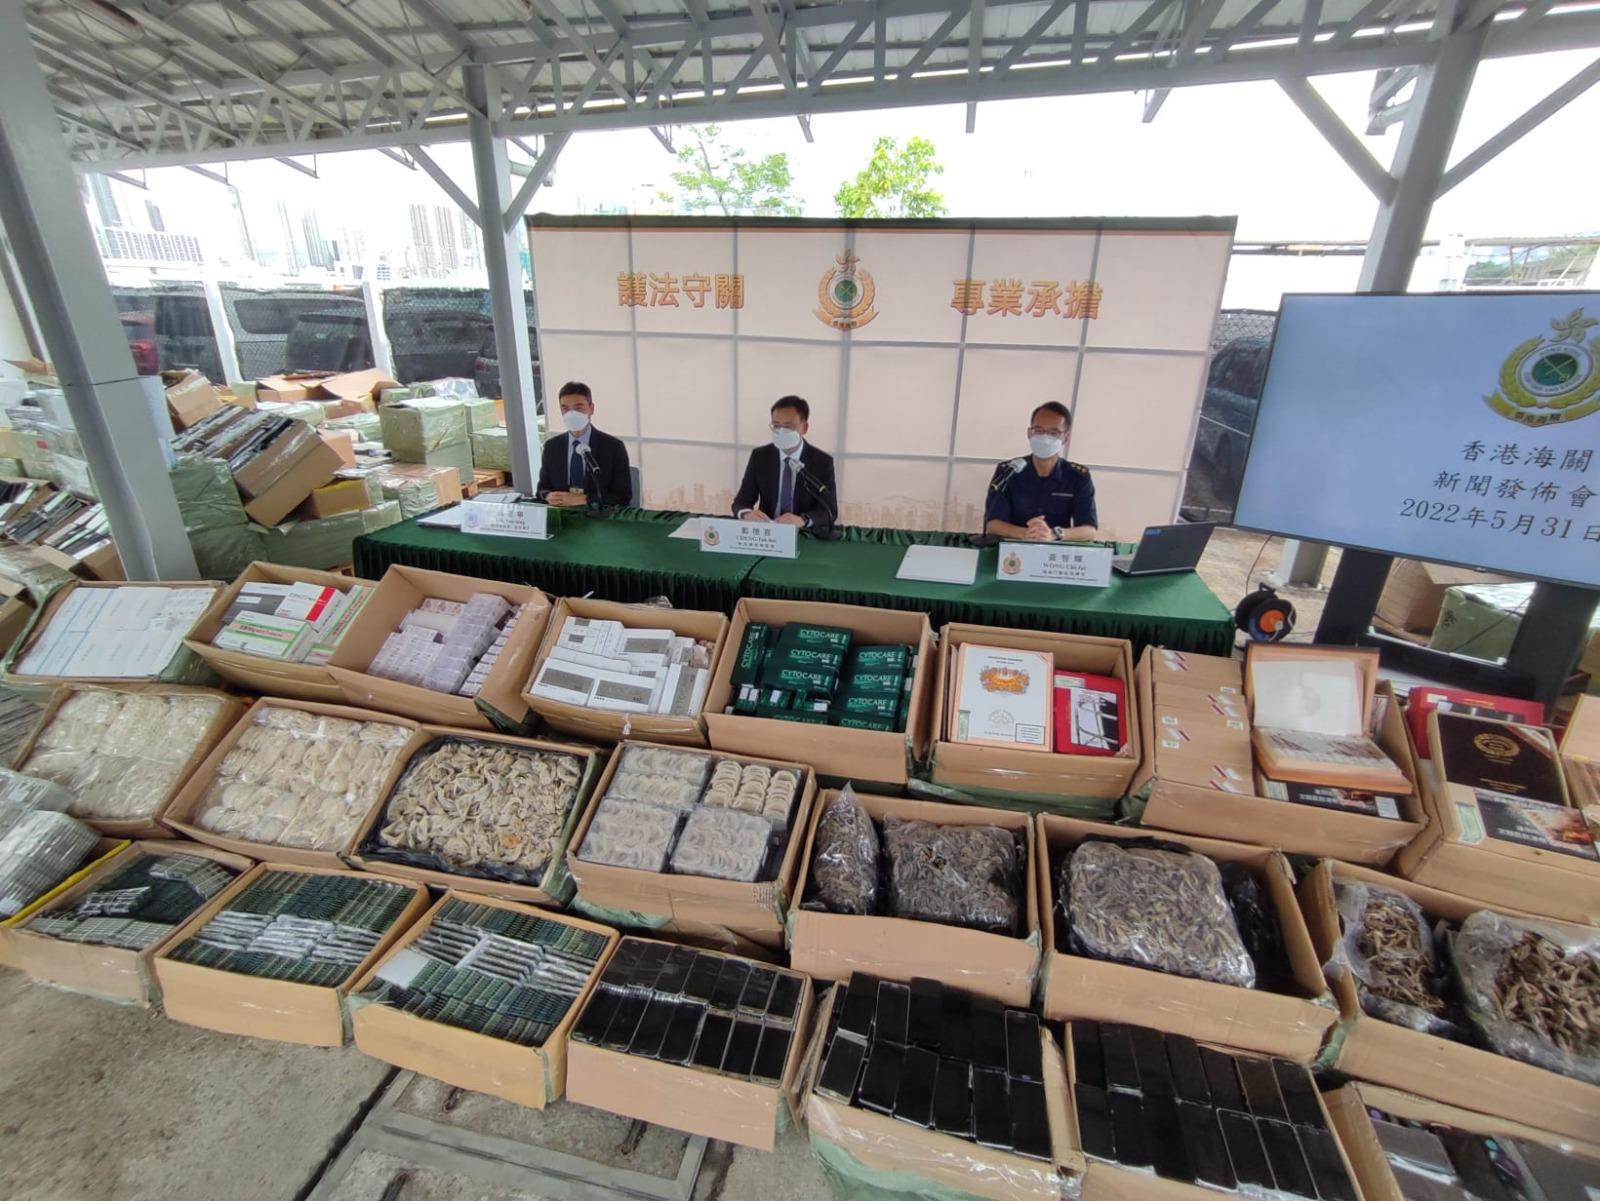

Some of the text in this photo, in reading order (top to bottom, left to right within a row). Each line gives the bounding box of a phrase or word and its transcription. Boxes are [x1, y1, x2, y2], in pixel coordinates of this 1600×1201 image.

[617, 271, 745, 309] 護法守關
[951, 278, 1103, 320] 專業承擔
[1460, 440, 1594, 473] 香港海關
[1432, 470, 1598, 508] 新聞發佈會
[1400, 498, 1600, 543] 2022年5月31日
[799, 629, 839, 639] CYTOCARE
[790, 649, 832, 659] CYTOCARE
[859, 651, 895, 659] CYTOCARE
[781, 669, 822, 679] CYTOCARE
[854, 674, 891, 682] CYTOCARE
[848, 697, 887, 706] CYTOCARE
